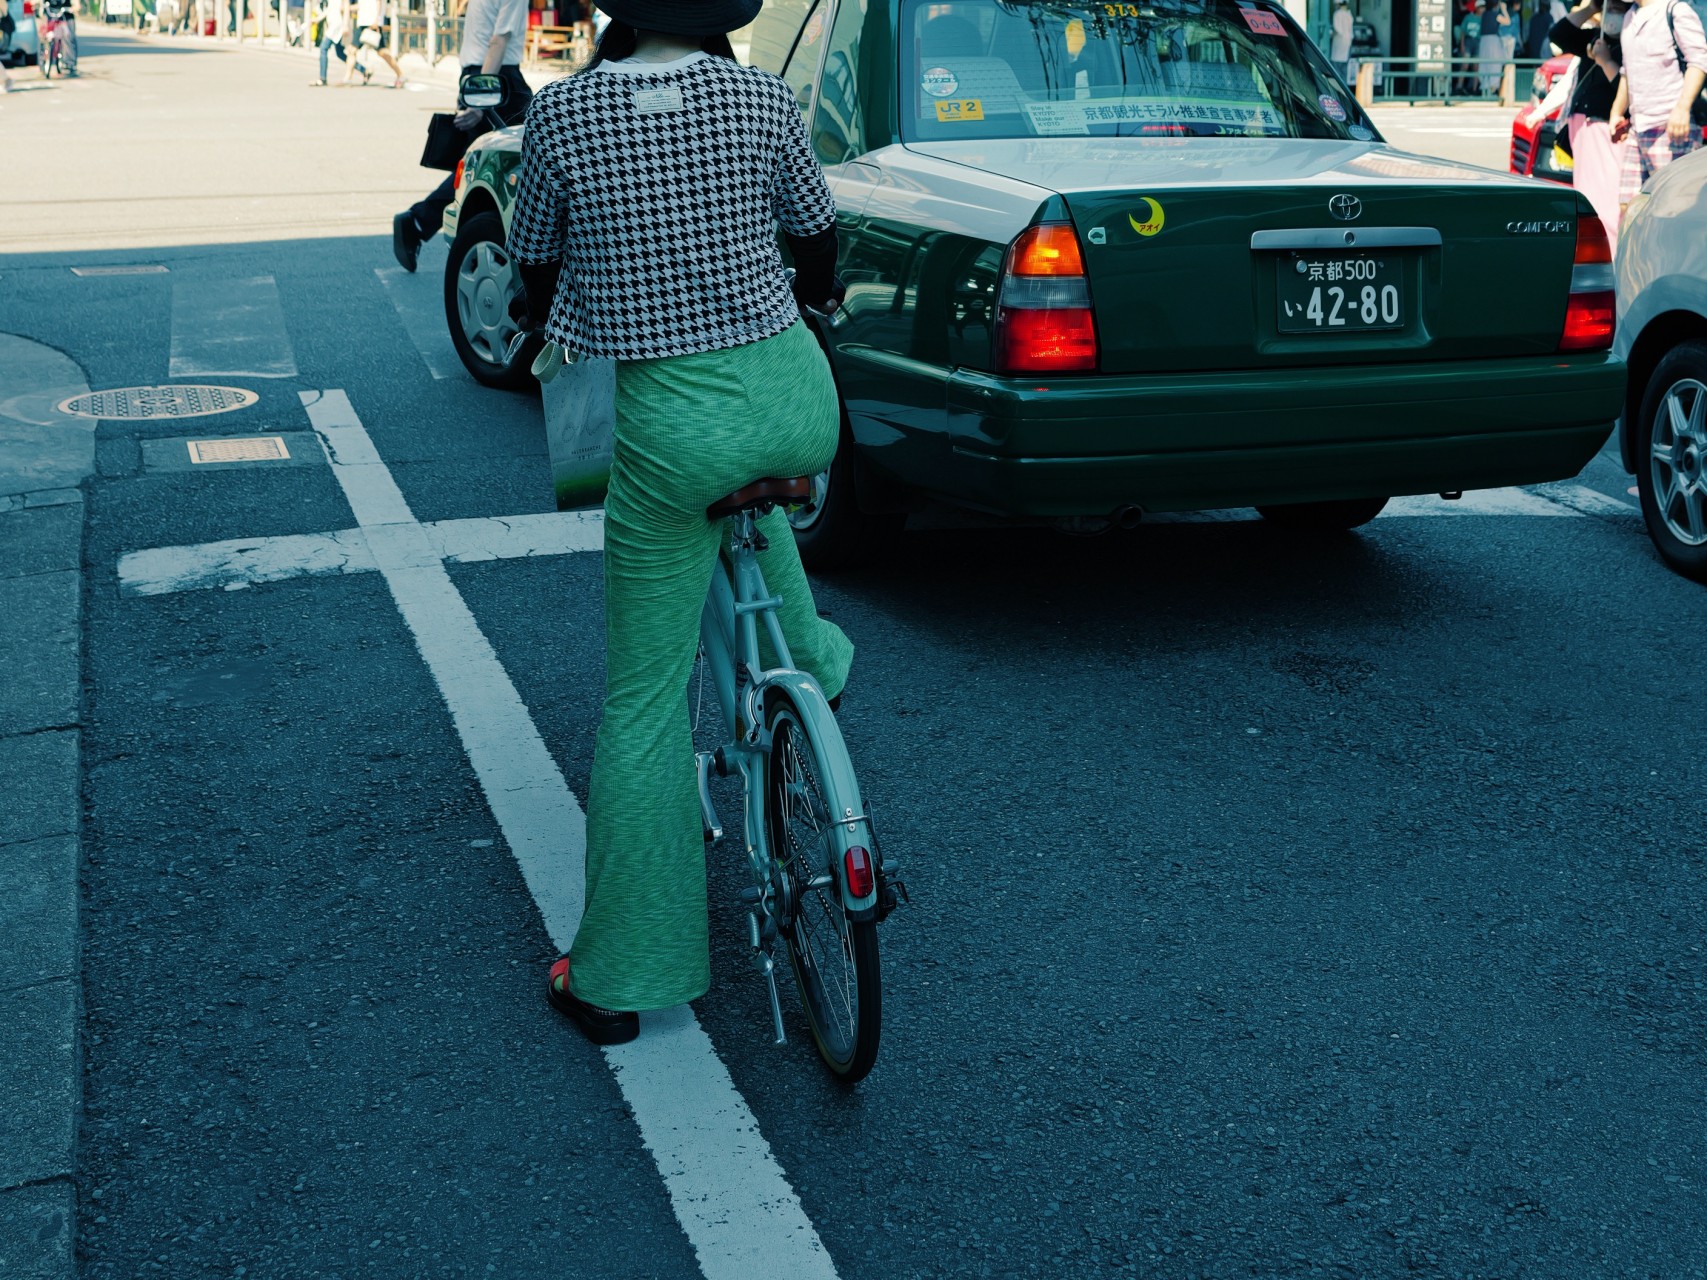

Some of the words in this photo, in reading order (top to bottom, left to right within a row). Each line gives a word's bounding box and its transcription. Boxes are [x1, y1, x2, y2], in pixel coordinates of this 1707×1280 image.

[1104, 4, 1138, 17] 373
[940, 102, 961, 112] JR
[966, 101, 976, 111] 2
[1082, 103, 1274, 124] 京都観光モラル推進宣言事業者
[1139, 223, 1160, 232] アオイ
[1506, 220, 1573, 233] COMFORT
[1284, 300, 1303, 317] い
[1306, 284, 1399, 326] 42-80
